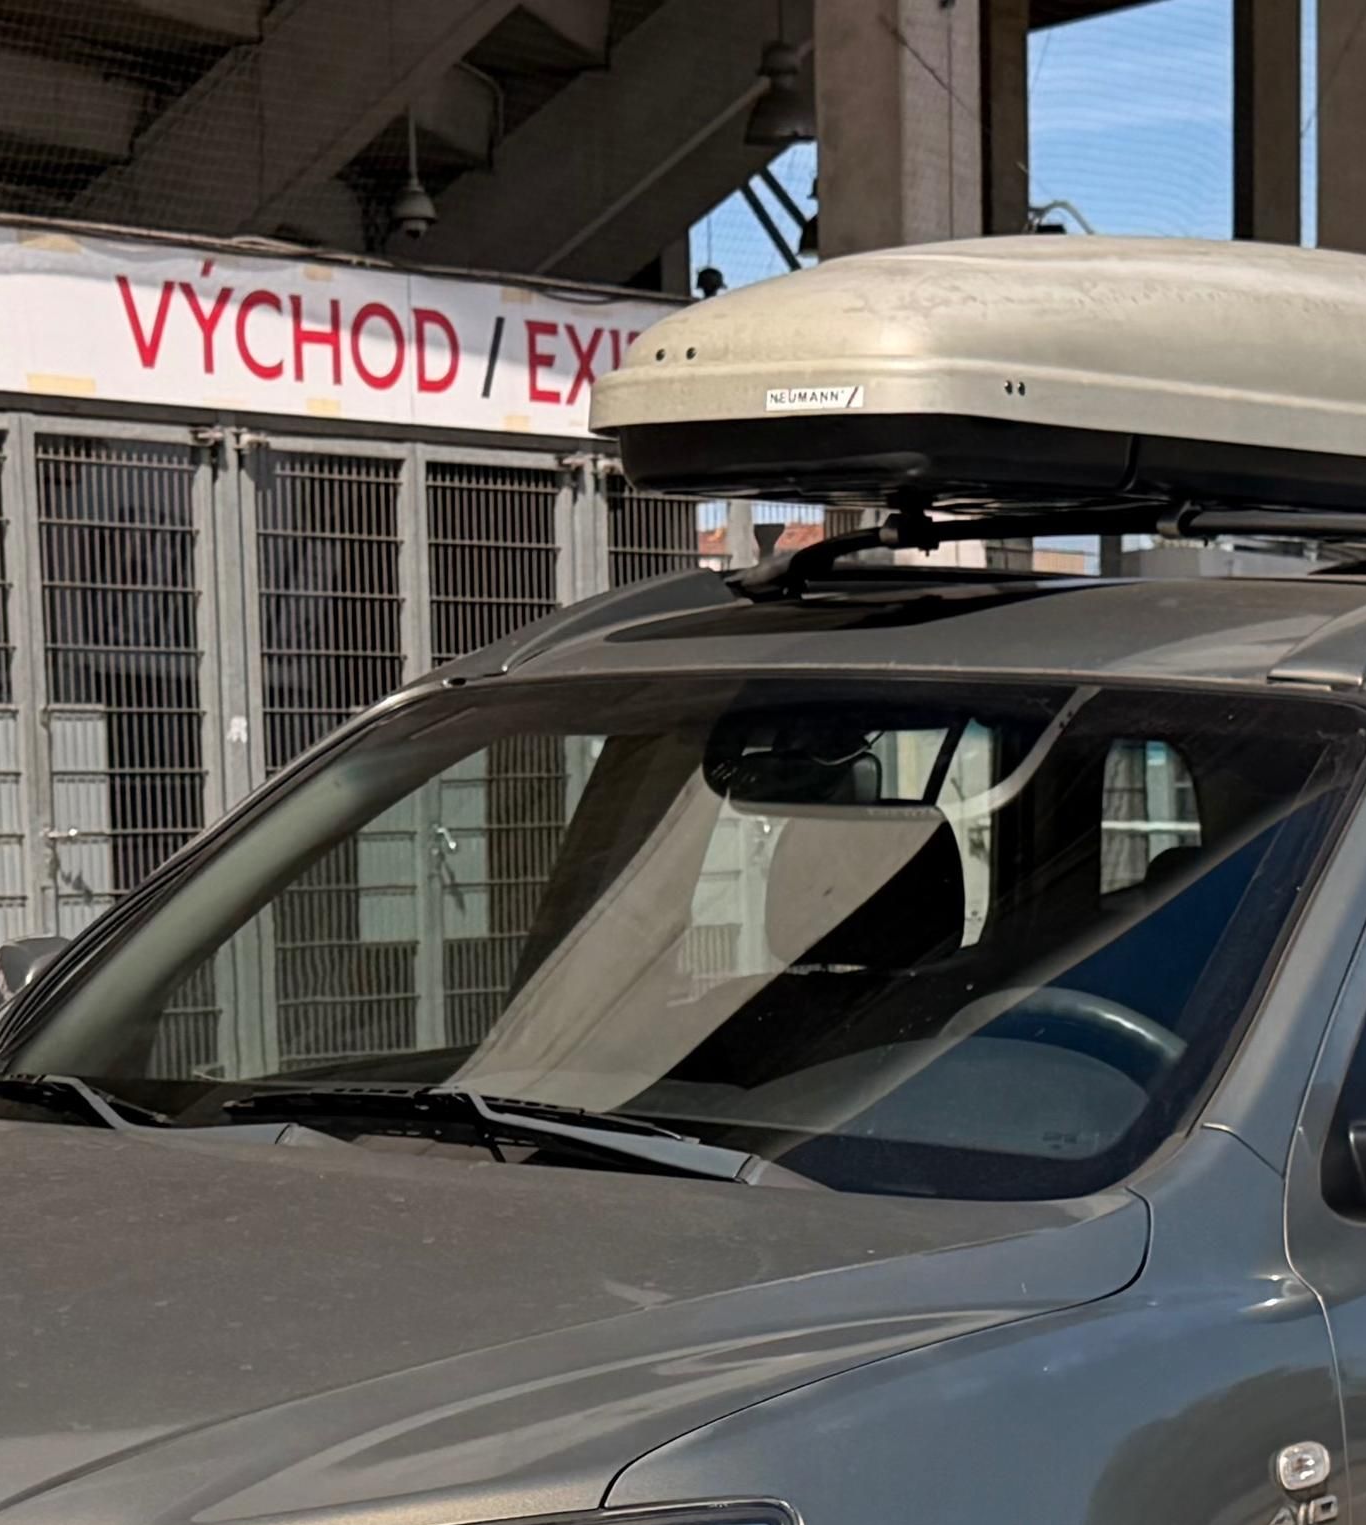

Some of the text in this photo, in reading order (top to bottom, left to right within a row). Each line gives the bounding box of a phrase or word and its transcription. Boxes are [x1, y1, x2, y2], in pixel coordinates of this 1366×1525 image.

[115, 259, 460, 394] VÝCHOD
[524, 319, 642, 405] EXI
[769, 391, 840, 404] NEUMANN
